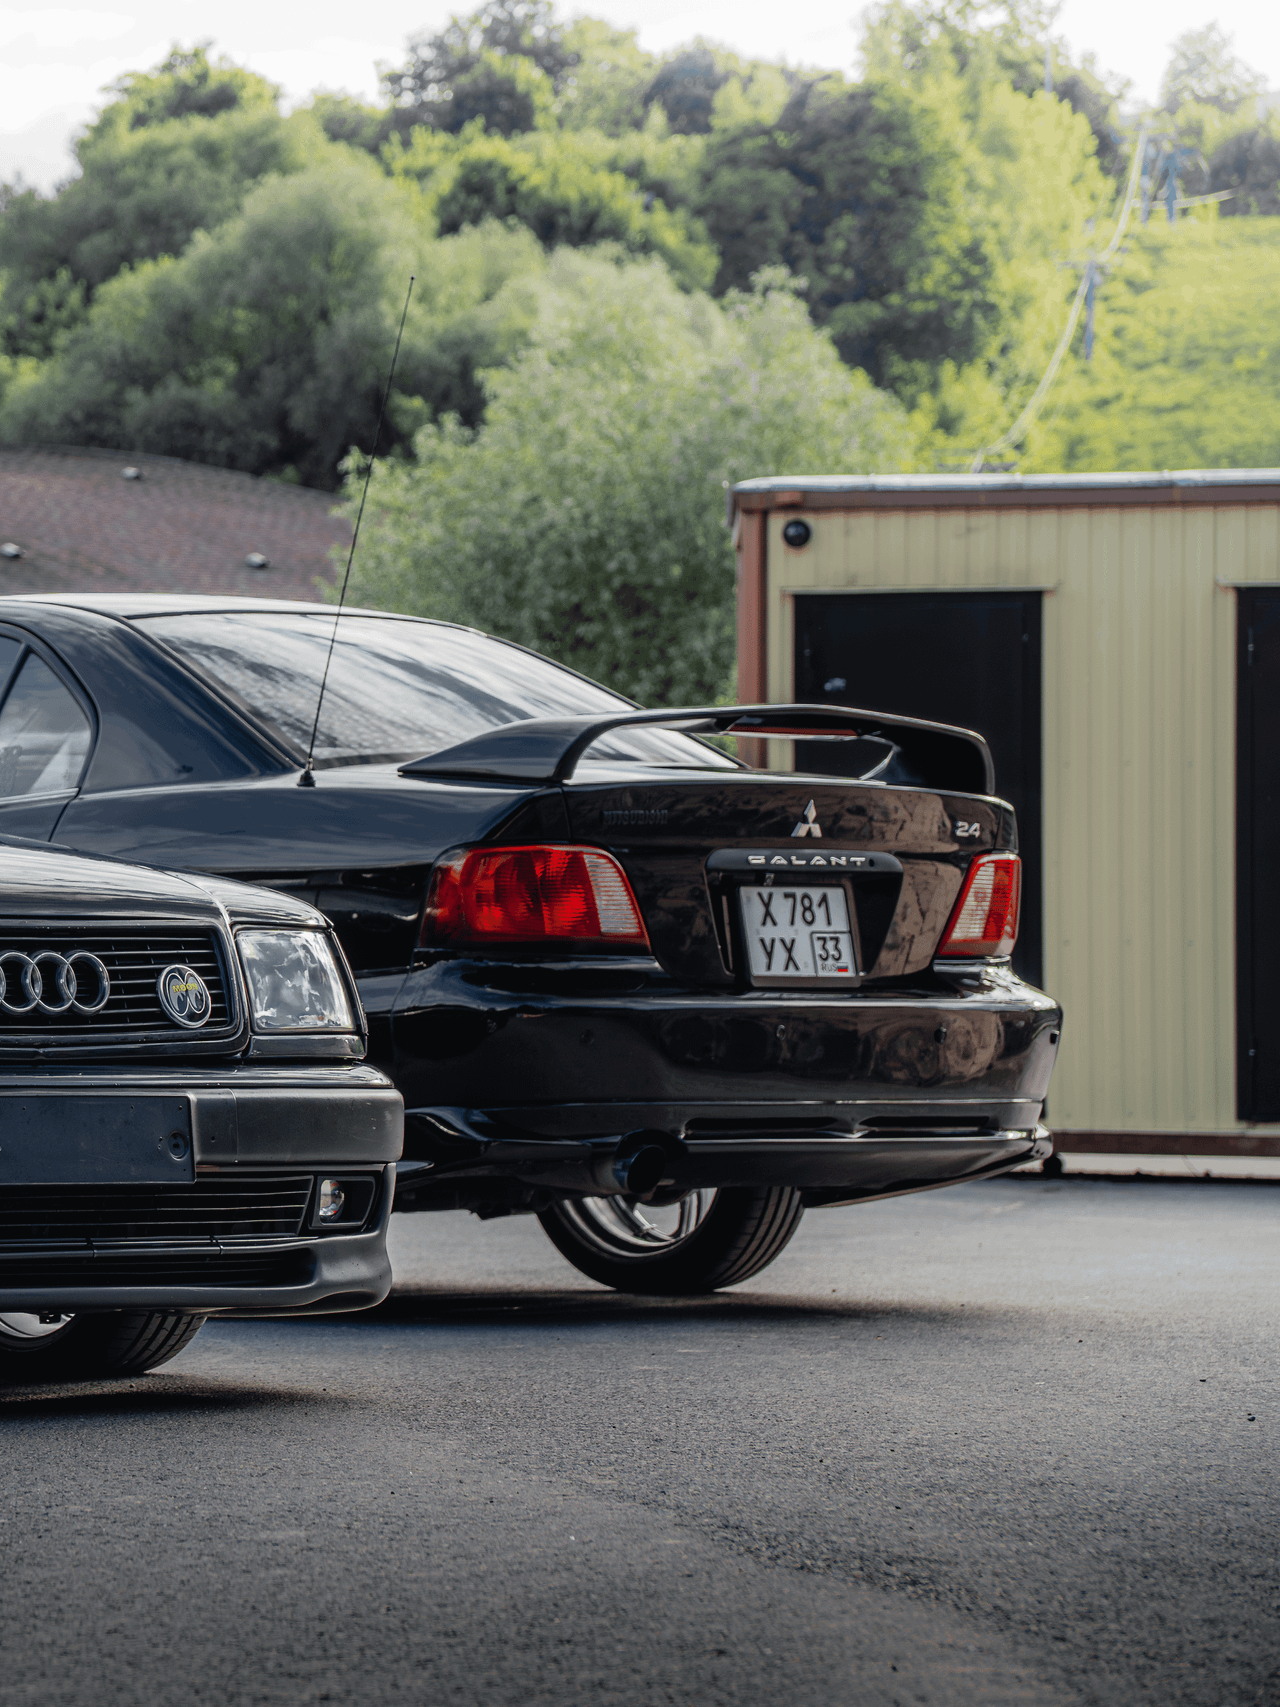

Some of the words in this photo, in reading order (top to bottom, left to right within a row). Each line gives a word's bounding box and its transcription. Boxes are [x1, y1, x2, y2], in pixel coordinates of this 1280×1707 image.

[747, 855, 866, 867] GALANT
[817, 937, 842, 961] 33
[821, 963, 837, 973] RUS
[172, 982, 198, 993] MOON
